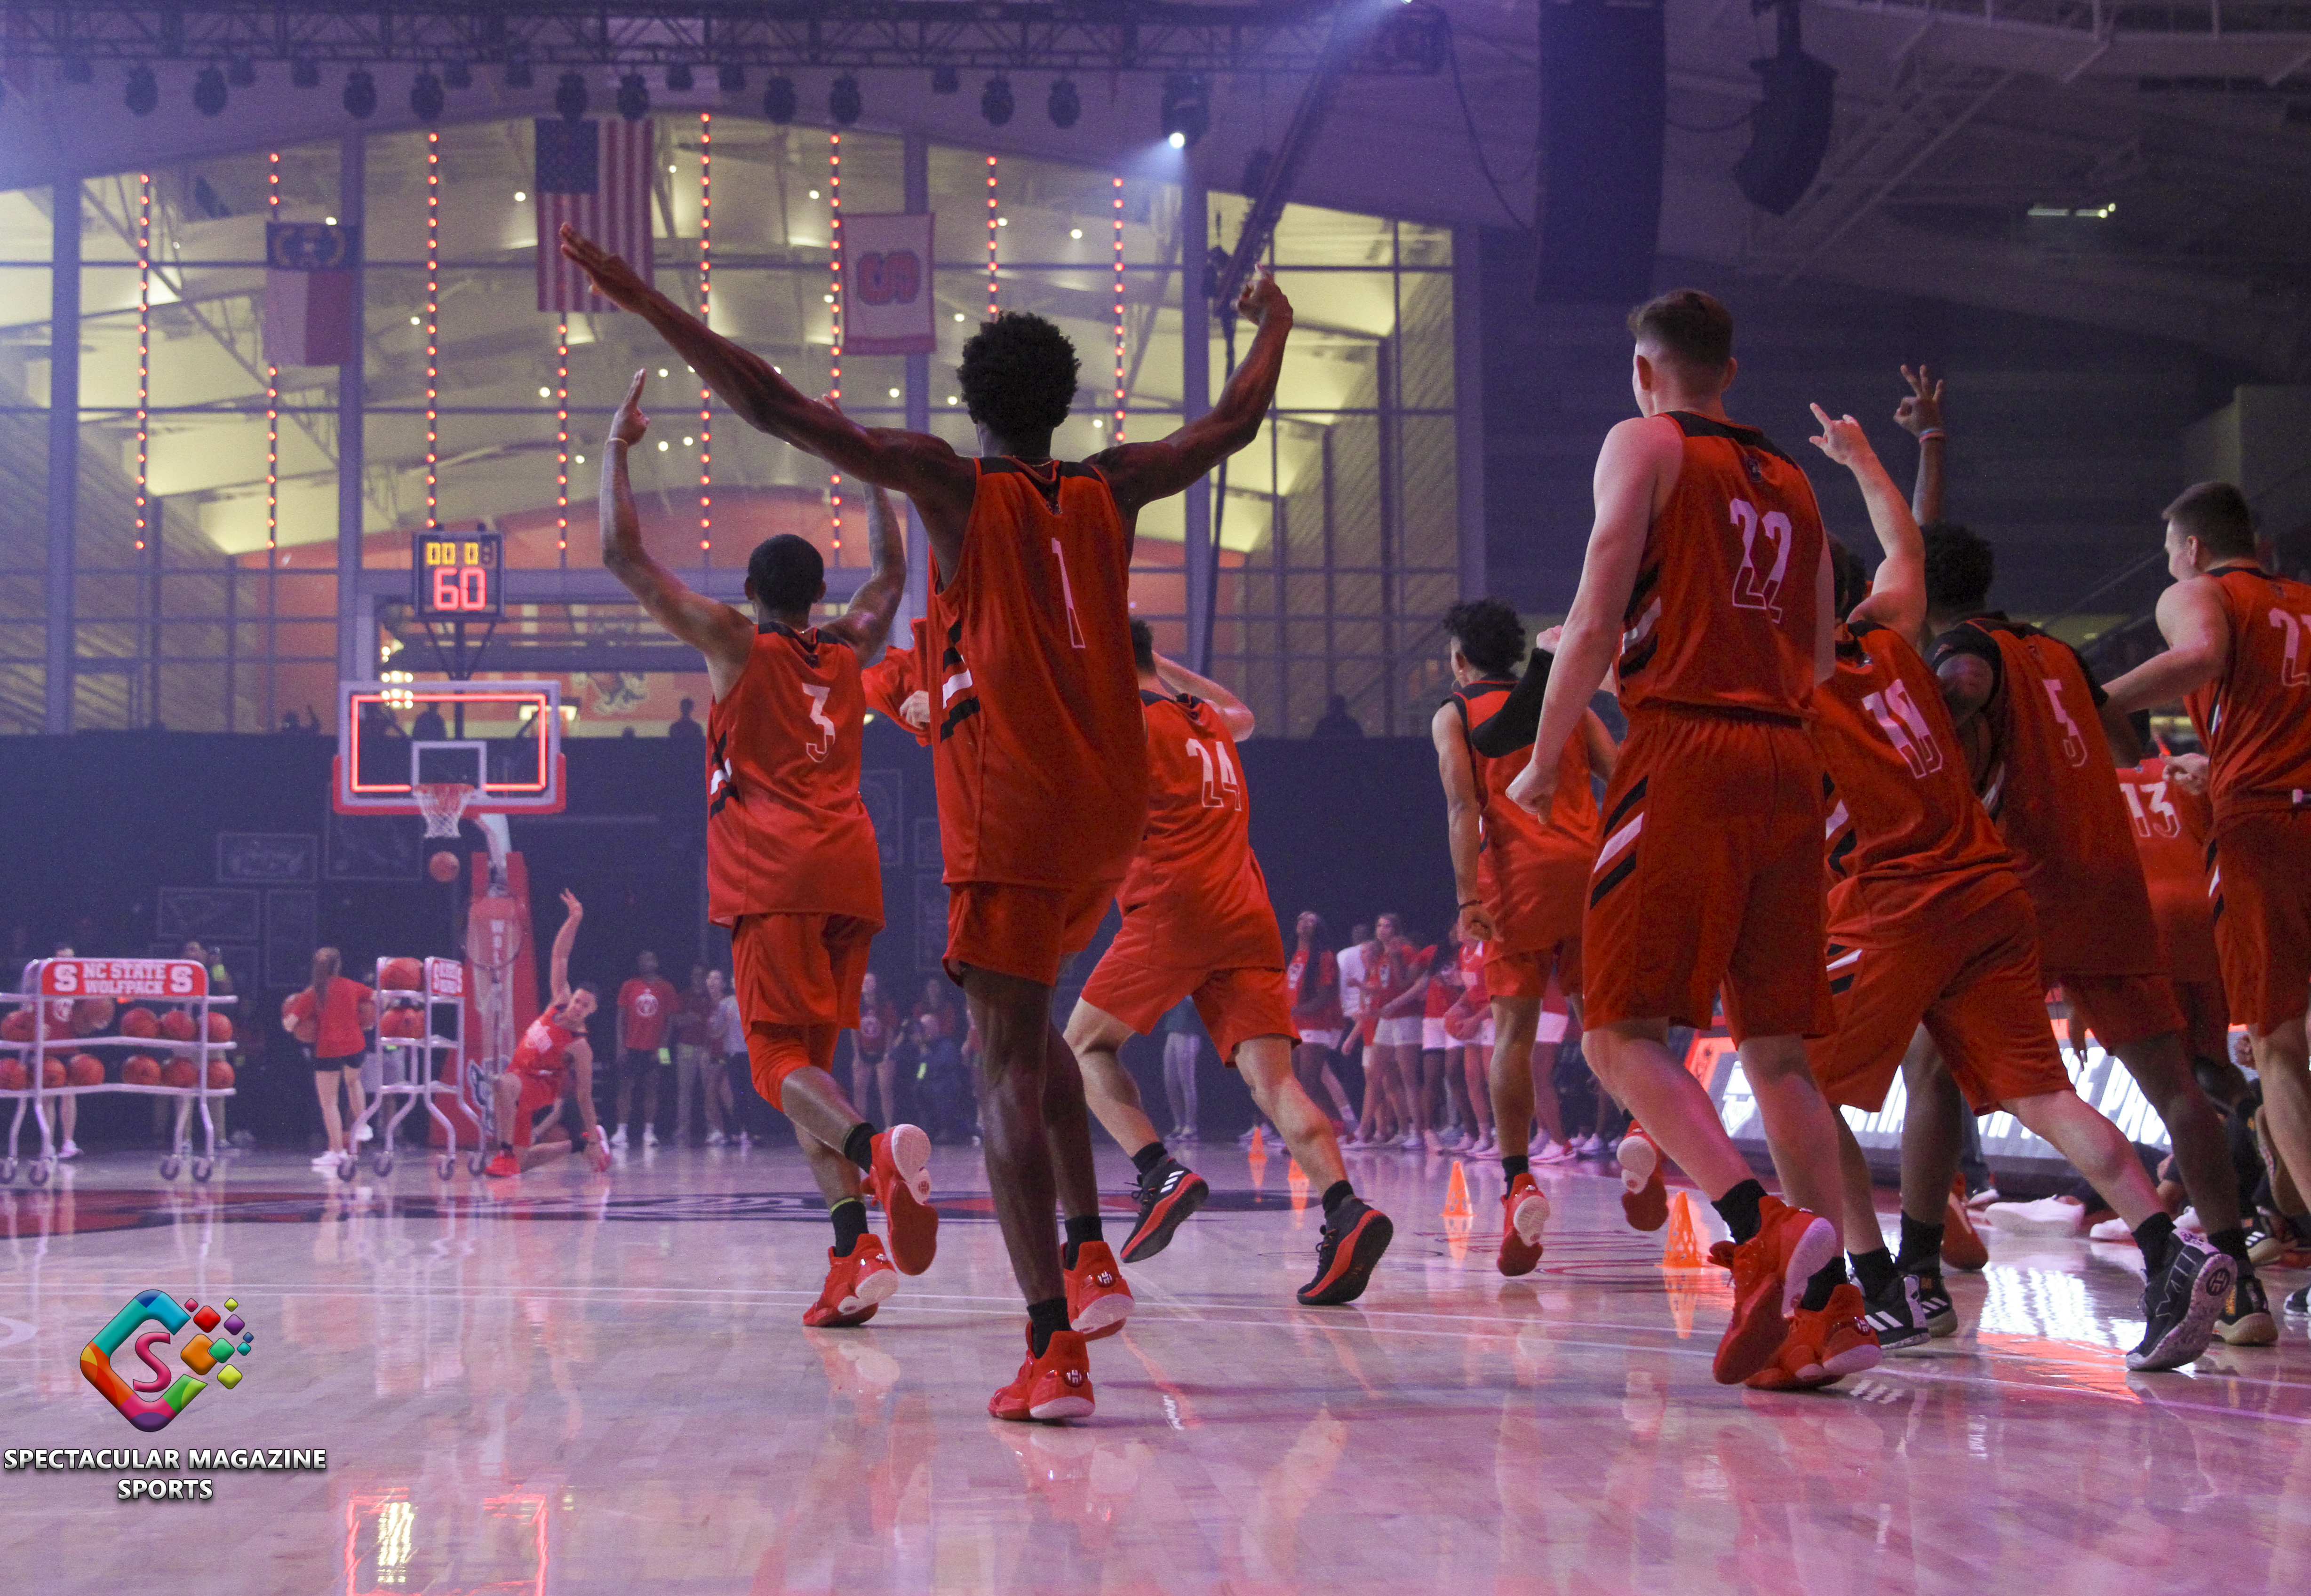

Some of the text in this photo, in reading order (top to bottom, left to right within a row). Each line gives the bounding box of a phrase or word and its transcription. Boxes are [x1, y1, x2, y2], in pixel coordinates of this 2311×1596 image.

[433, 567, 486, 611] 60
[1730, 498, 1792, 624] 22
[1051, 537, 1086, 649] 1
[801, 682, 836, 763] 3
[2042, 679, 2088, 767] 5
[1186, 738, 1242, 811] 24
[2120, 781, 2181, 838] 13
[54, 964, 78, 992] S
[82, 962, 167, 980] NC STATE
[84, 979, 164, 994] WOLFPACK
[170, 965, 193, 993] S
